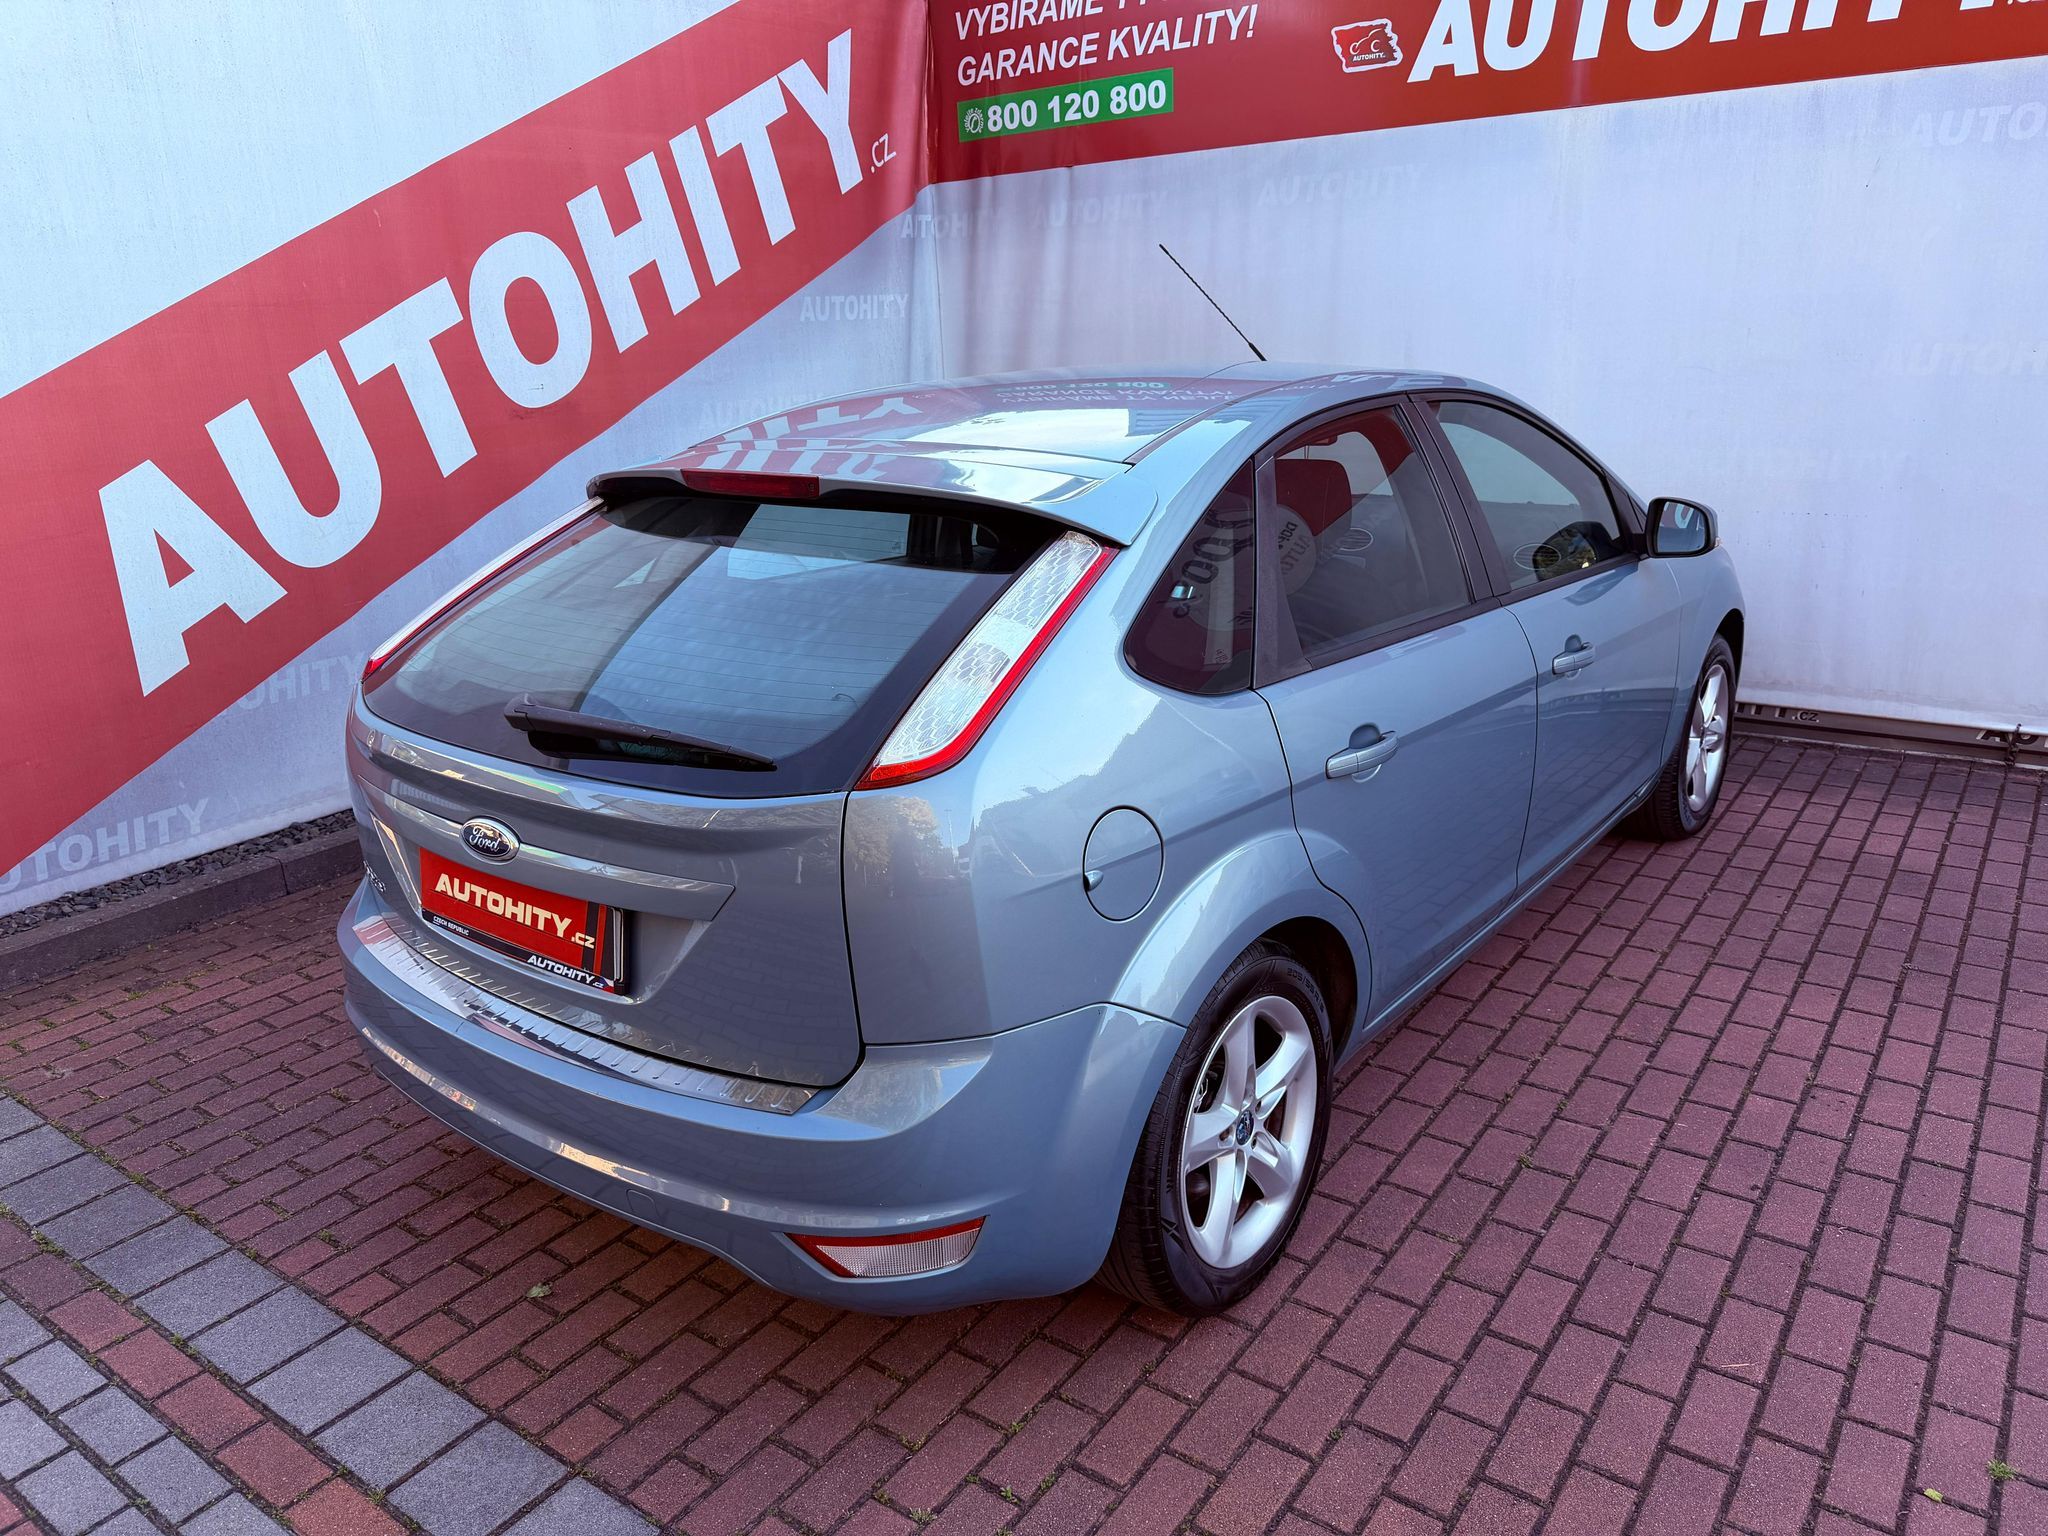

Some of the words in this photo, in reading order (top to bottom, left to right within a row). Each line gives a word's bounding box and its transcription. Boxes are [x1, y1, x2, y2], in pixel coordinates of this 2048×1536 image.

[957, 33, 1100, 86] GARANCE
[1107, 4, 1258, 61] KVALITY!
[987, 102, 1038, 132] 800
[1047, 90, 1100, 123] 120
[1109, 79, 1167, 115] 800
[1907, 102, 2048, 148] AUTO
[800, 293, 909, 321] AUTOHITY
[468, 824, 502, 853] Ford
